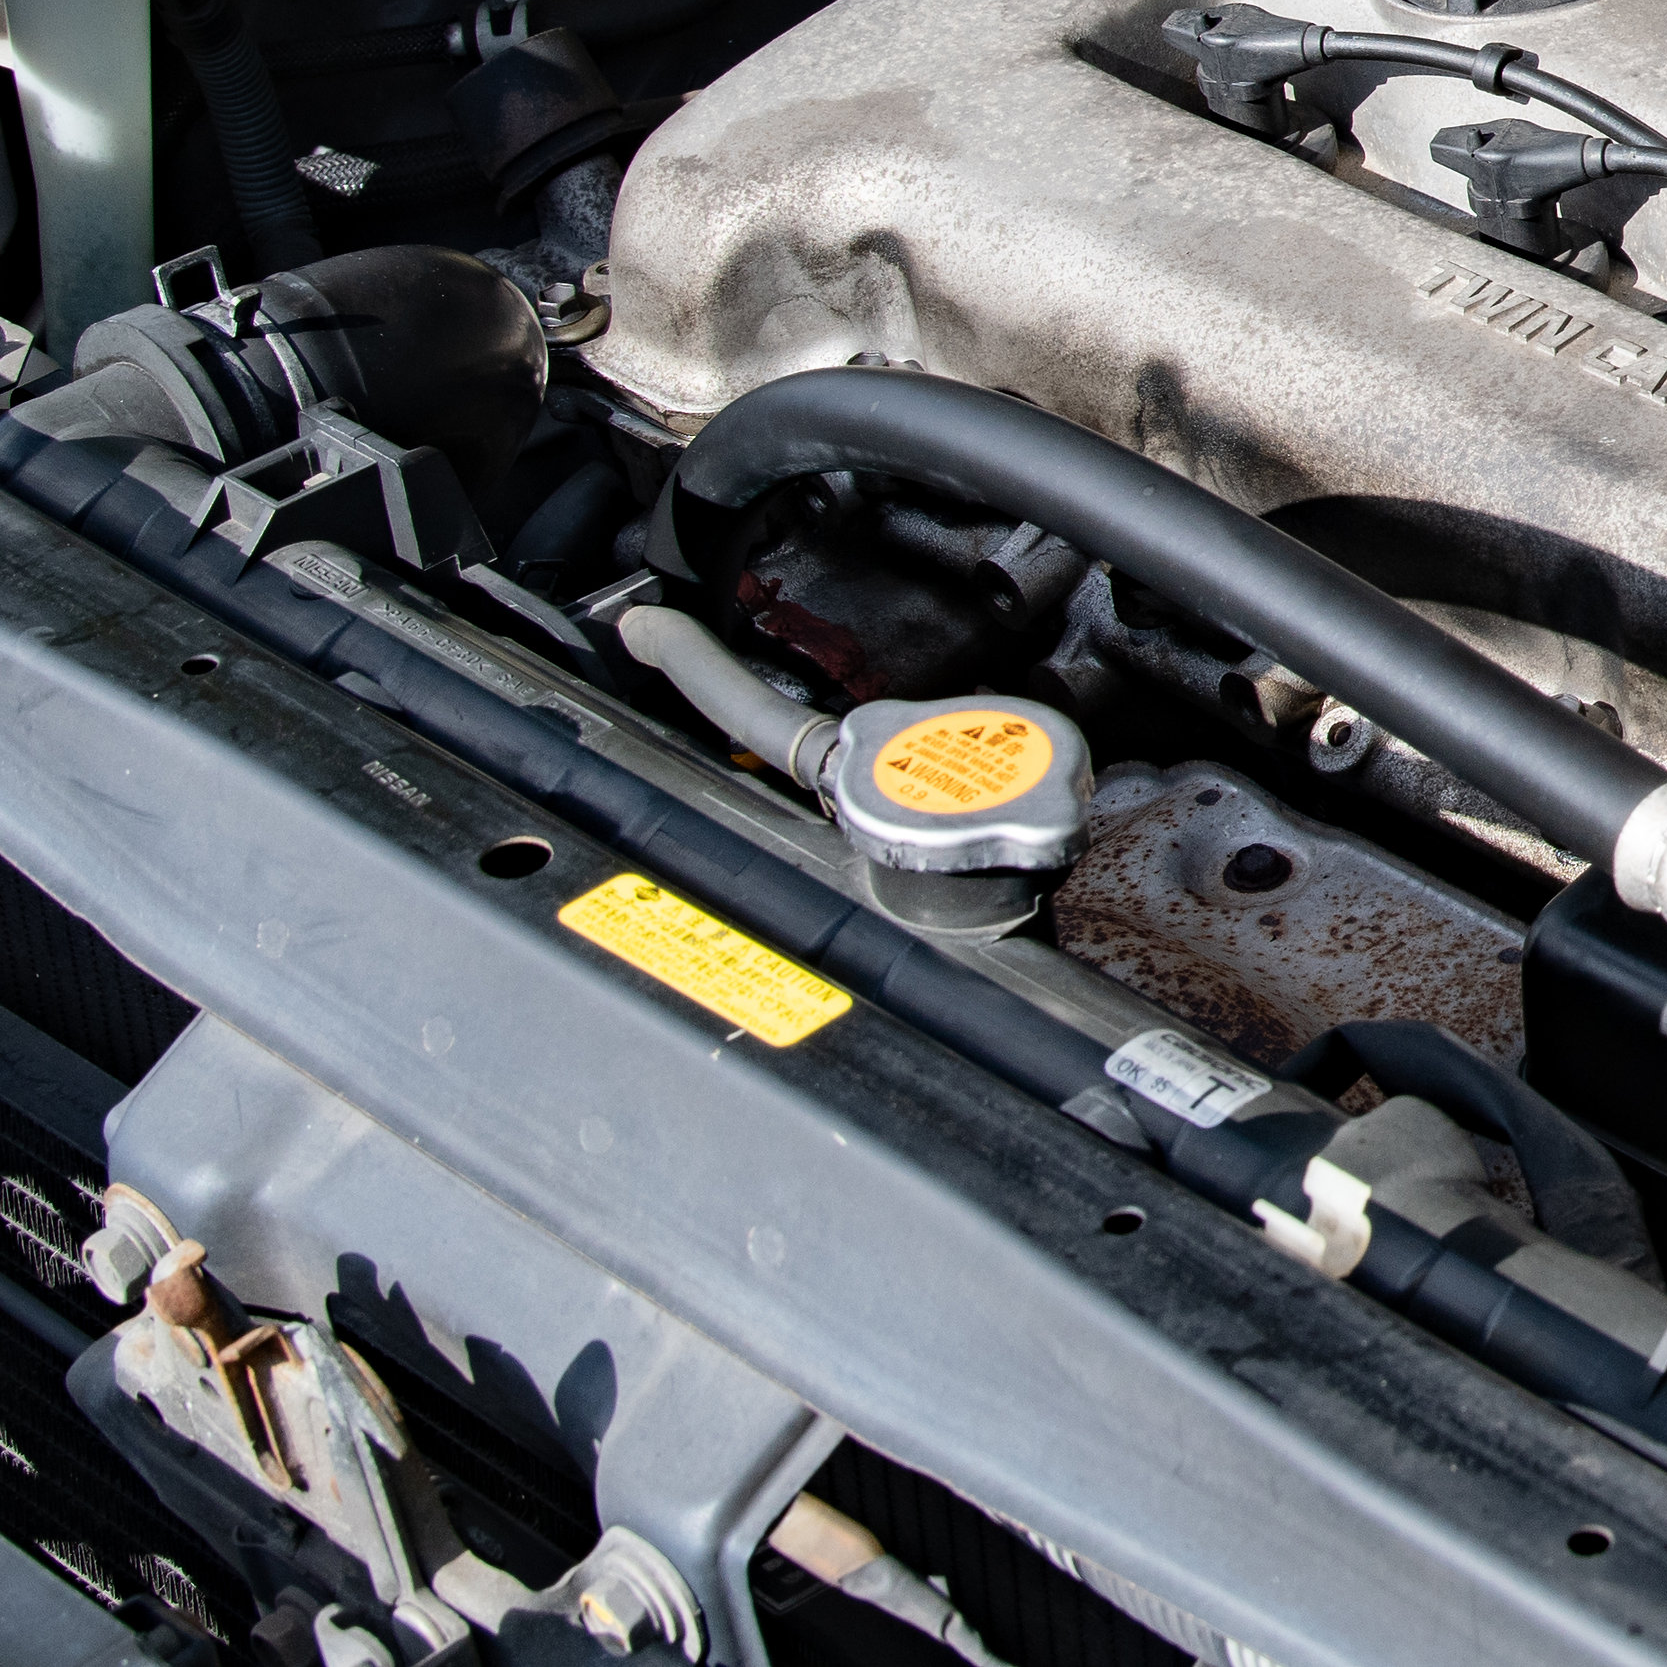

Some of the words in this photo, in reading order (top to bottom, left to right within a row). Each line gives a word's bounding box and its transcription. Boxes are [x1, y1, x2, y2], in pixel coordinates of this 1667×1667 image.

[1415, 259, 1598, 357] TWIN
[292, 555, 365, 598] NISSAN
[361, 758, 432, 808] NISSAN
[899, 784, 928, 800] 0.9
[908, 762, 981, 803] WARNING
[753, 952, 839, 1003] CAUTION
[1189, 1075, 1237, 1110] T
